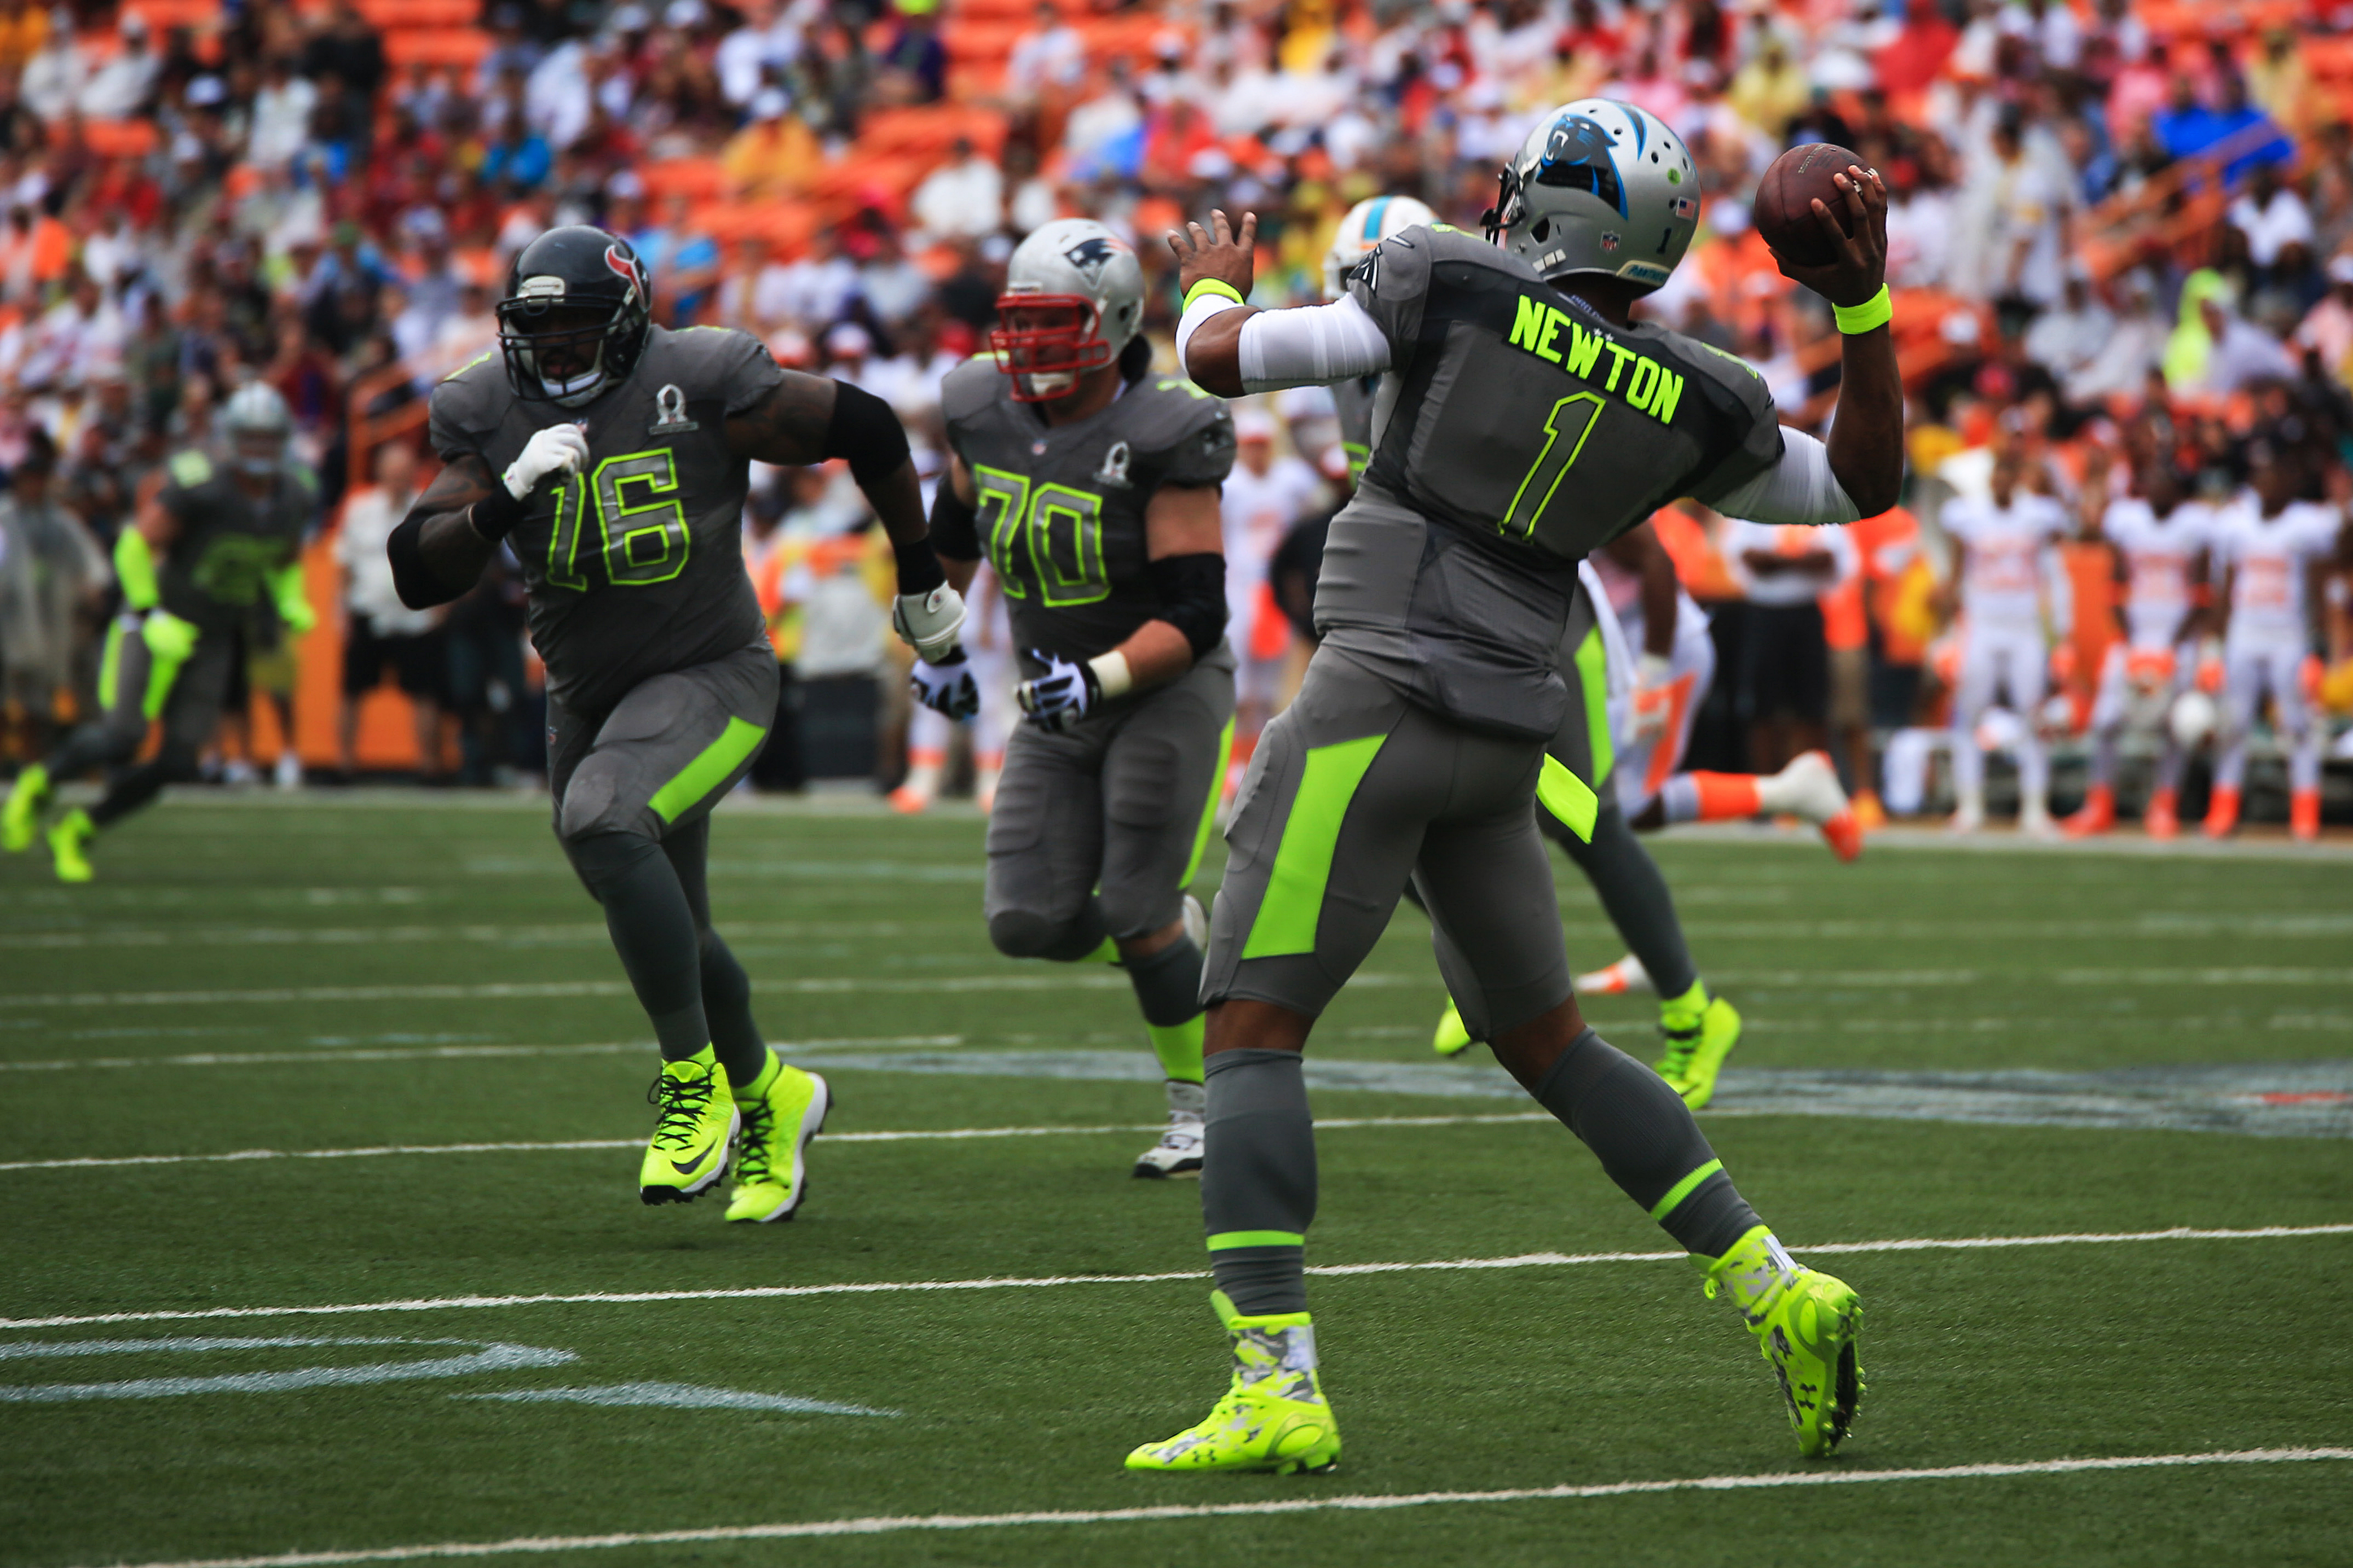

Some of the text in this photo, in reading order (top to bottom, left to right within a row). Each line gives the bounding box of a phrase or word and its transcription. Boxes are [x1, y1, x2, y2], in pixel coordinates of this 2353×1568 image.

[1656, 227, 1672, 254] 1
[1509, 294, 1684, 425] NEWTON
[974, 462, 1111, 607] 70
[1497, 390, 1607, 541] 1
